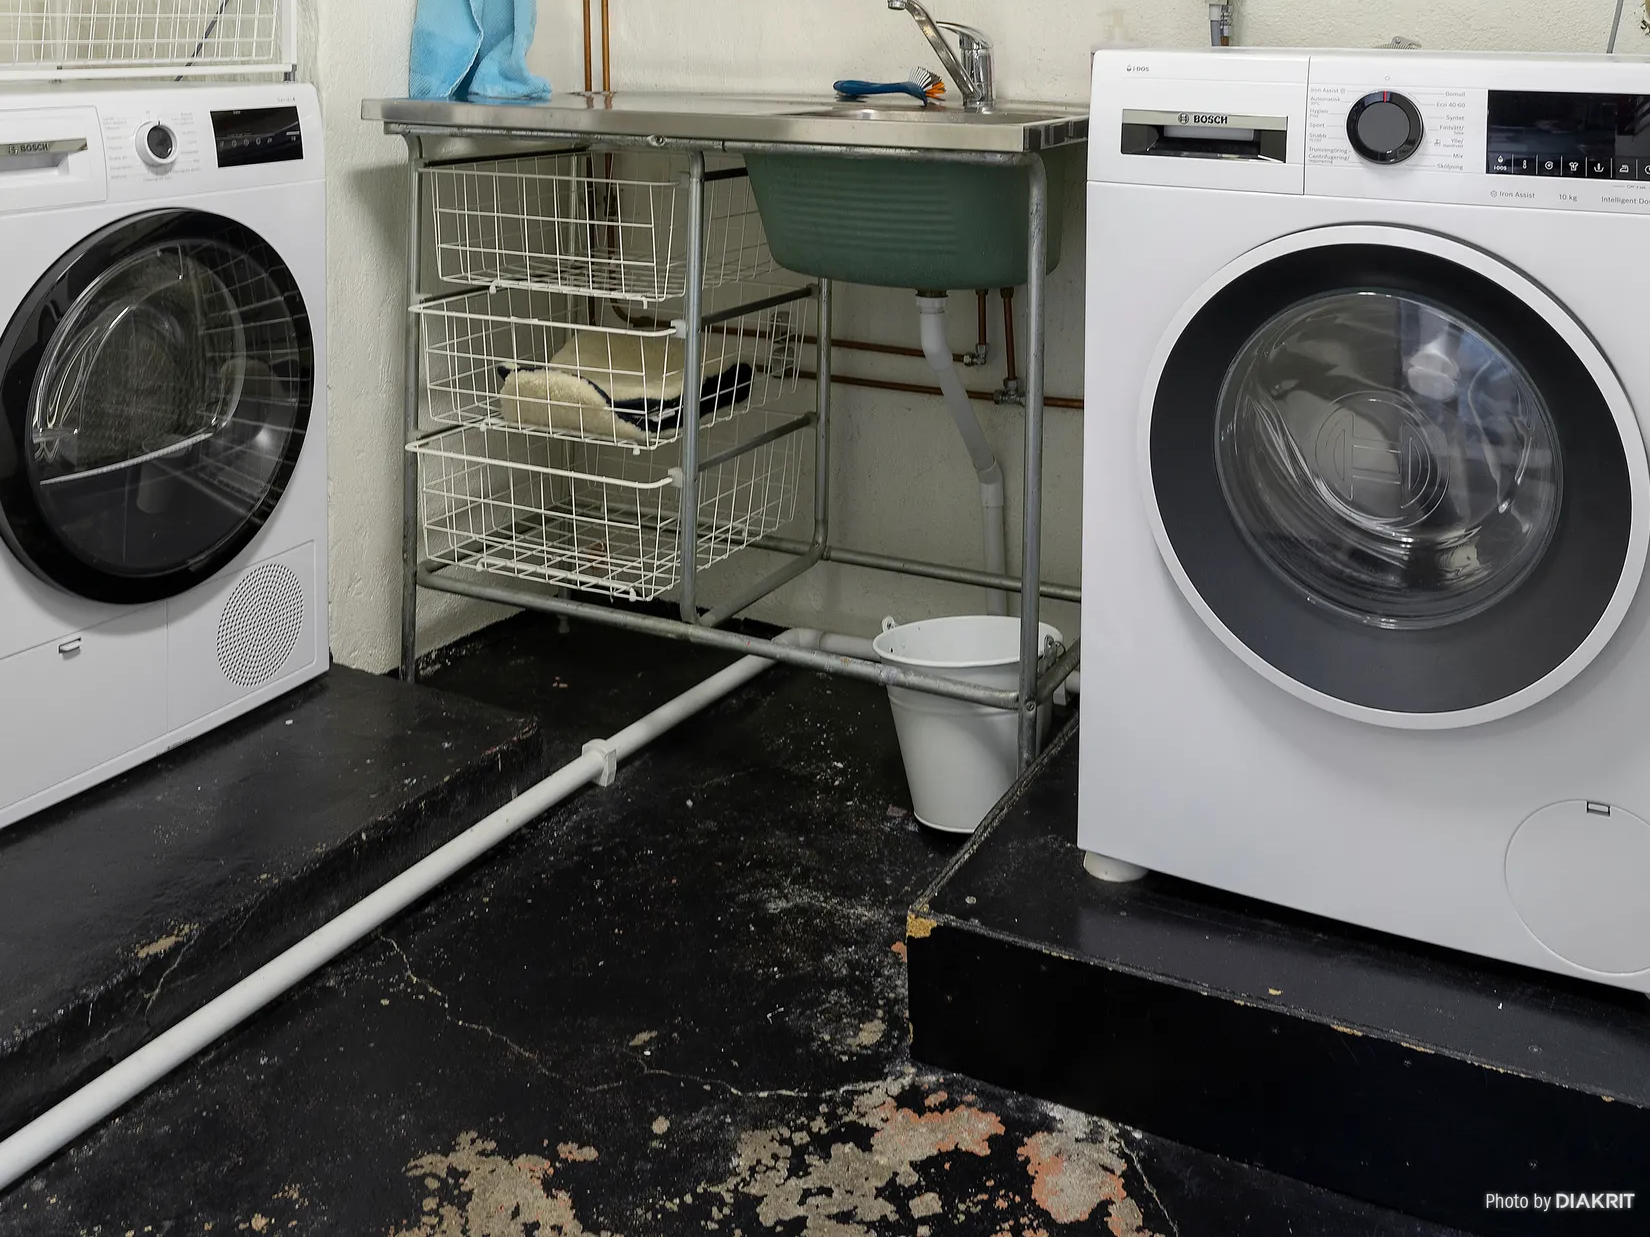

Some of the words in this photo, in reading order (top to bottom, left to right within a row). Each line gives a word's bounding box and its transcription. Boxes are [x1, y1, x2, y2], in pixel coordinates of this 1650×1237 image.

[1193, 115, 1228, 125] BOSCH
[20, 142, 49, 152] BOSCH
[1499, 190, 1513, 198] Iron
[1515, 191, 1535, 199] Assist
[1568, 194, 1578, 202] kg
[1601, 196, 1637, 205] Intelligent
